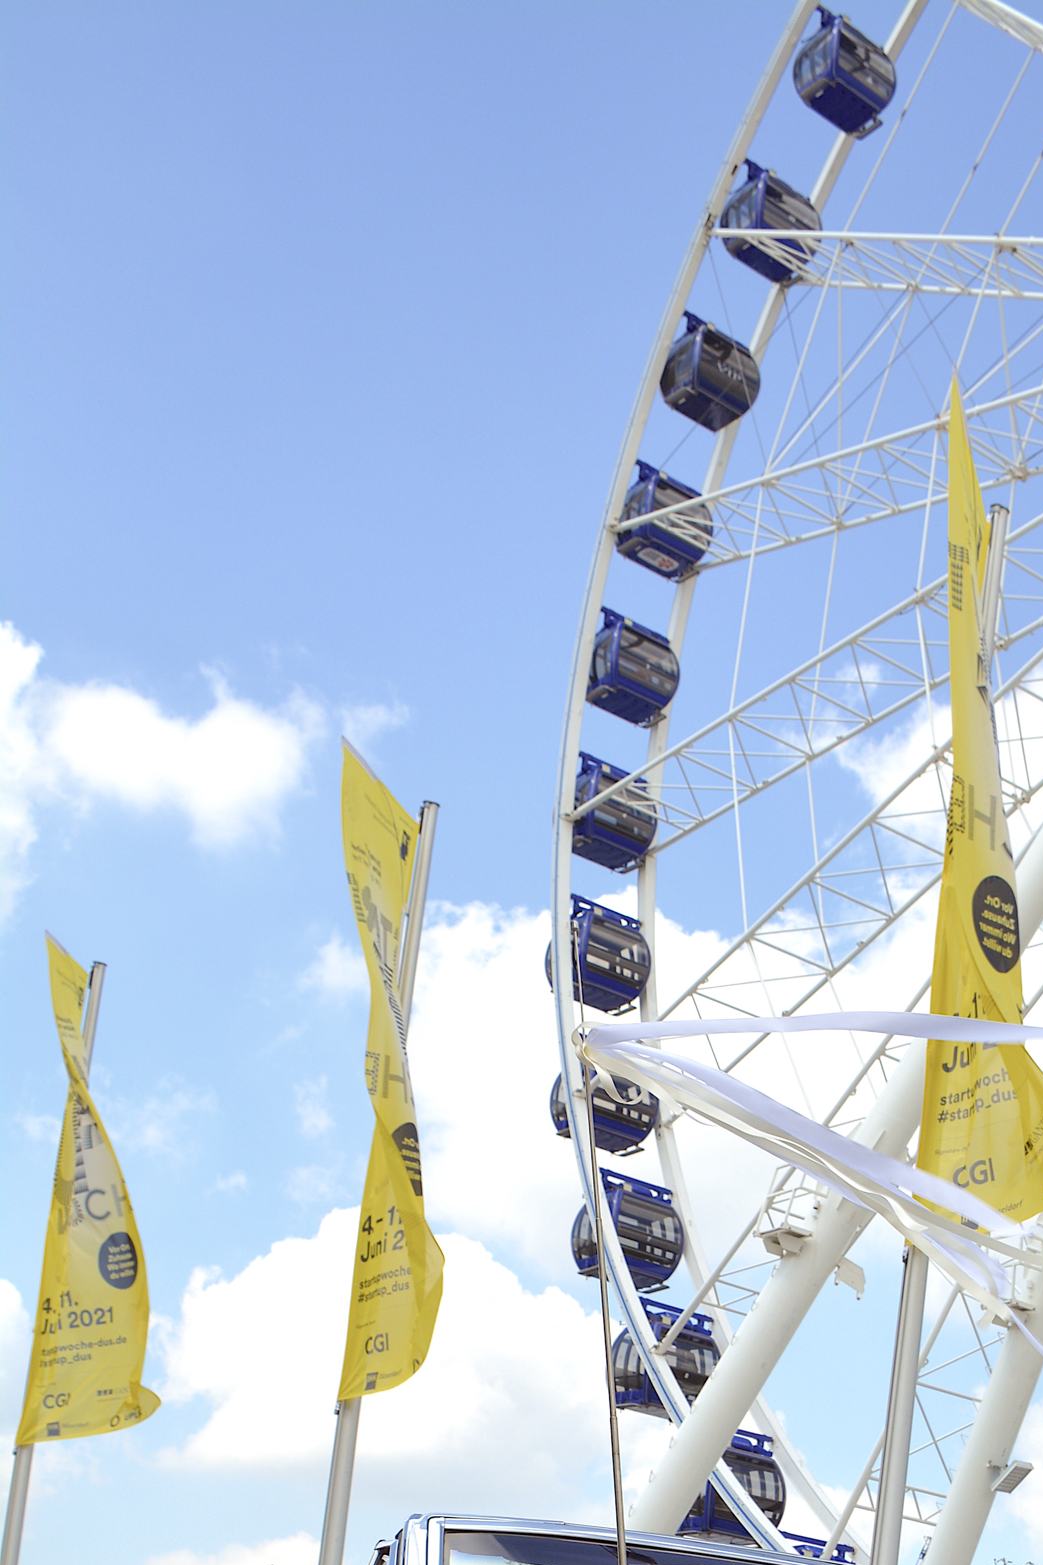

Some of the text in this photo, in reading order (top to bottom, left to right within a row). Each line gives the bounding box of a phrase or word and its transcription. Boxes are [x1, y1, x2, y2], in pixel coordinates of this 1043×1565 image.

[952, 1158, 995, 1188] CGI
[360, 1232, 387, 1262] Juni
[67, 1307, 114, 1329] 2021
[365, 1332, 389, 1355] CGI
